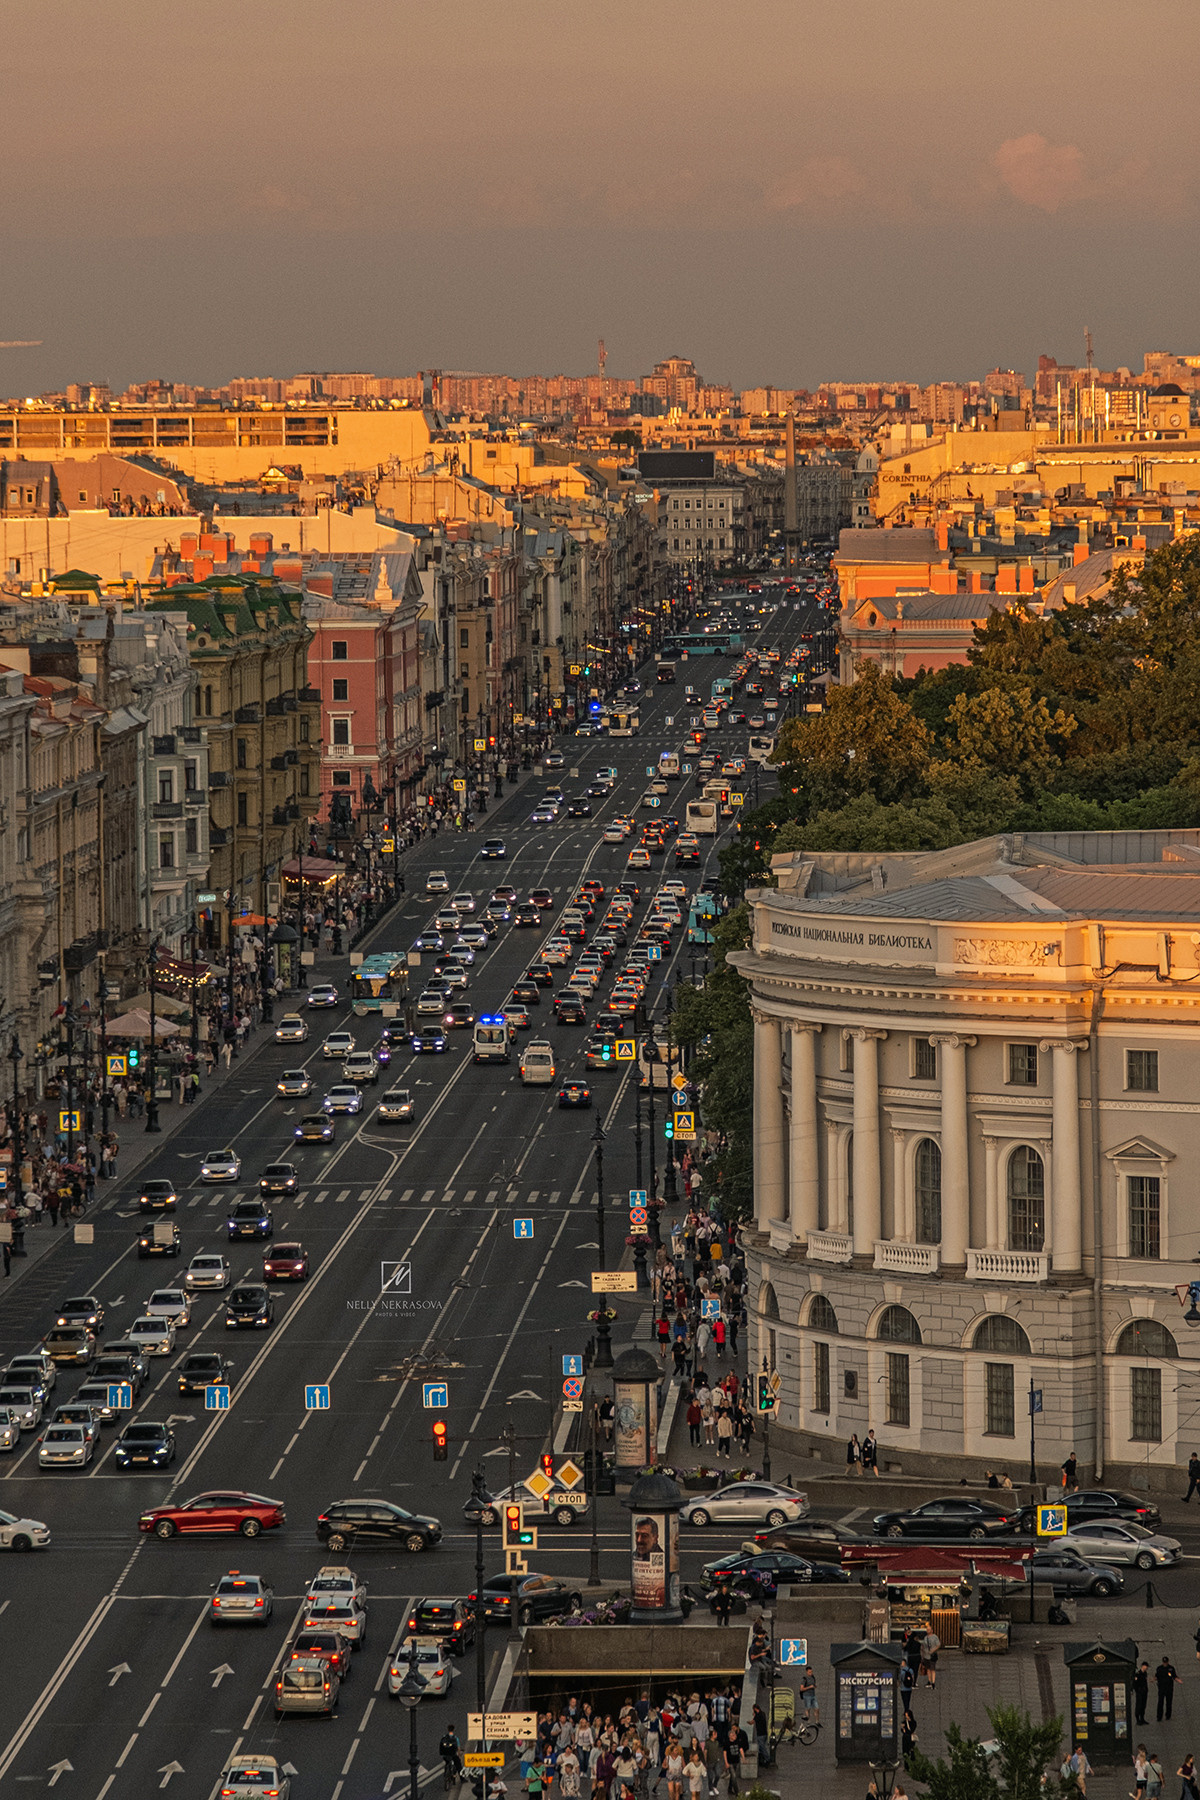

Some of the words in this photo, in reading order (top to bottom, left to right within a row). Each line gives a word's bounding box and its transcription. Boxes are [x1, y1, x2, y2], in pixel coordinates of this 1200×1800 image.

[803, 927, 864, 945] НАЦИОНАЛЬНАЯ
[868, 933, 932, 949] БИБЛИОТЕКА
[558, 1495, 582, 1503] СТОП
[840, 1677, 893, 1685] ЭКСКУРСИИ
